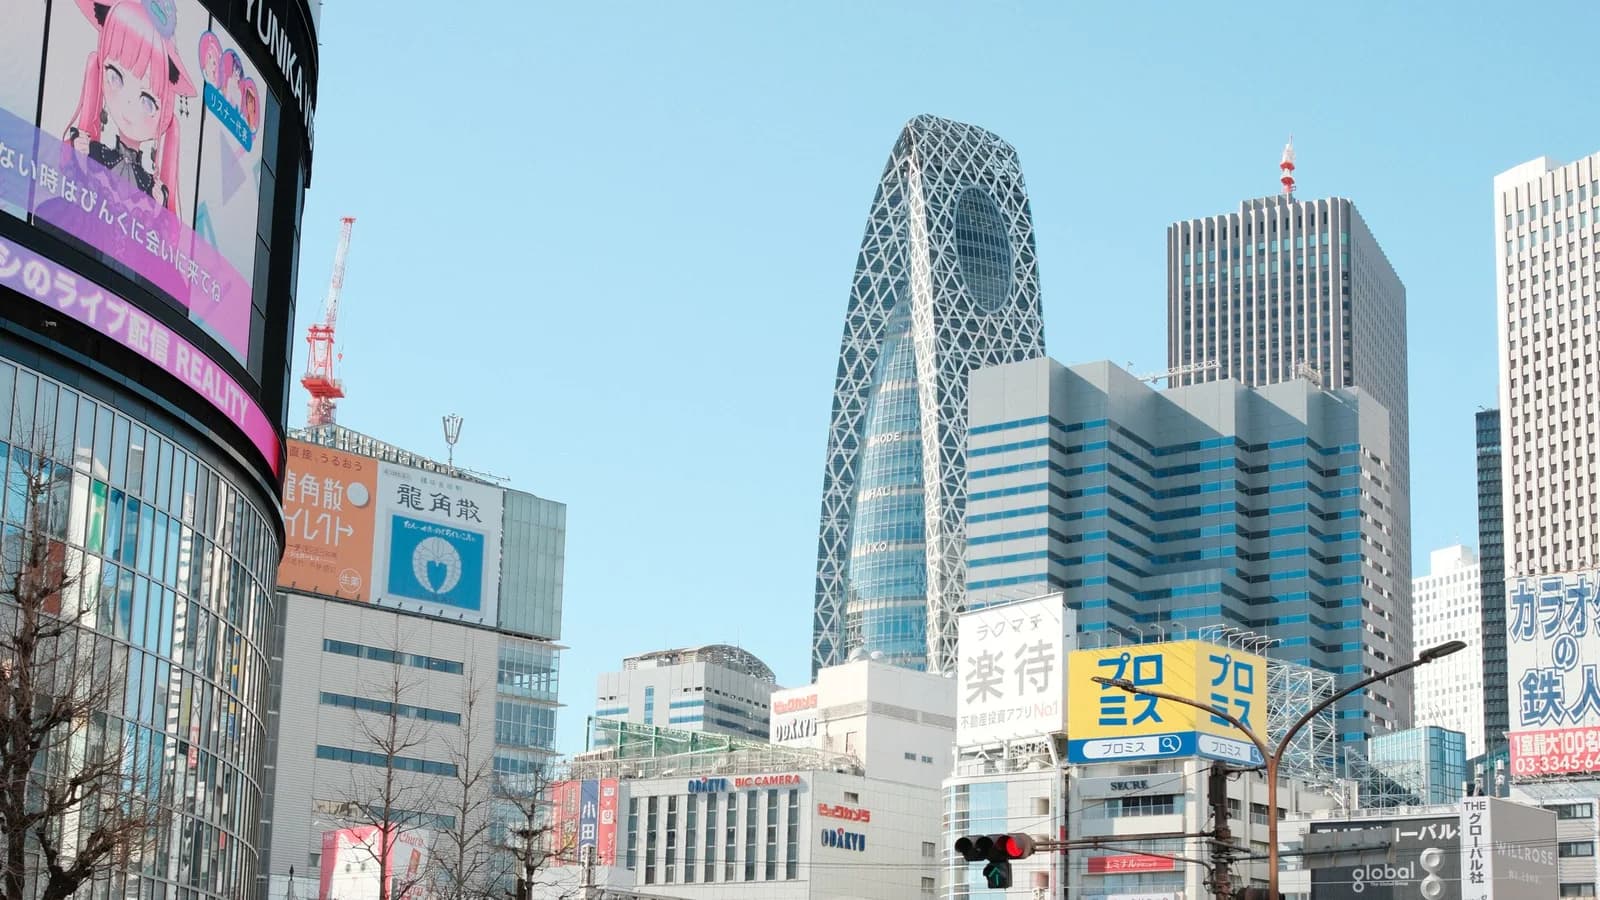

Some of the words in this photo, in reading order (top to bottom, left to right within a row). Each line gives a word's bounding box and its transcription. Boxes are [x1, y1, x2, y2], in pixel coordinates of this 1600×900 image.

[174, 341, 249, 423] REALITY
[397, 483, 482, 523] 龍角散
[284, 505, 354, 546] イレクト
[976, 613, 1043, 641] ラクマチ
[1552, 633, 1579, 670] の
[965, 638, 1056, 704] 楽待
[1209, 654, 1254, 694] プロ
[1519, 668, 1600, 725] 鉄人
[775, 718, 818, 742] ODAKYU
[1102, 742, 1146, 755] プロミス
[1211, 741, 1241, 756] プロミス
[688, 776, 726, 793] ODAKYU
[735, 777, 753, 788] BIC
[754, 774, 800, 786] CAMERA
[1110, 779, 1150, 791] SECRE
[817, 803, 871, 823] ビックカメラ
[1463, 801, 1486, 811] THE
[821, 827, 866, 852] ODAKYU
[1496, 840, 1555, 866] WILLROSE
[1352, 861, 1414, 893] global
